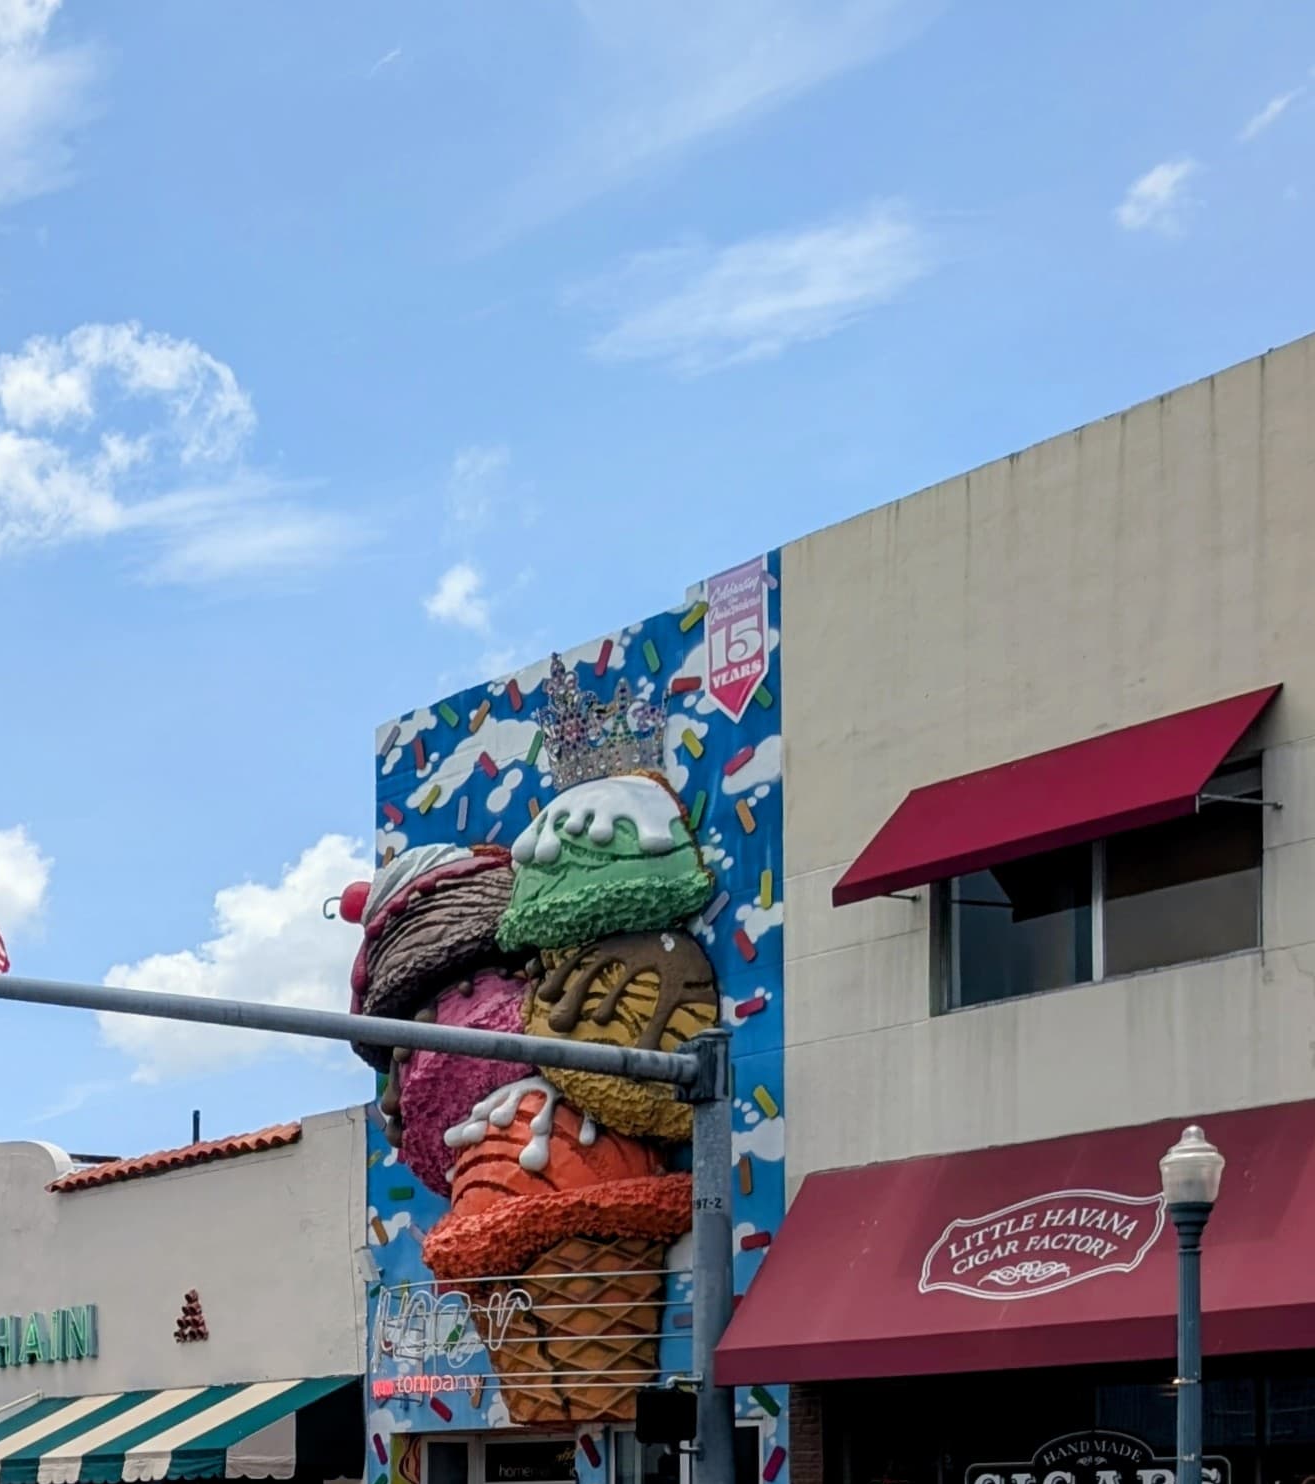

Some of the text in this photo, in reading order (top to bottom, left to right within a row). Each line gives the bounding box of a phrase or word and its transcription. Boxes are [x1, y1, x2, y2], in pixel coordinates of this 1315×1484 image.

[711, 614, 762, 672] 15
[712, 659, 762, 689] YEARS
[949, 1207, 1139, 1259] LITTLE HAVANA
[952, 1233, 1119, 1275] CIGAR FACTORY
[1042, 1439, 1143, 1466] HANDMADE
